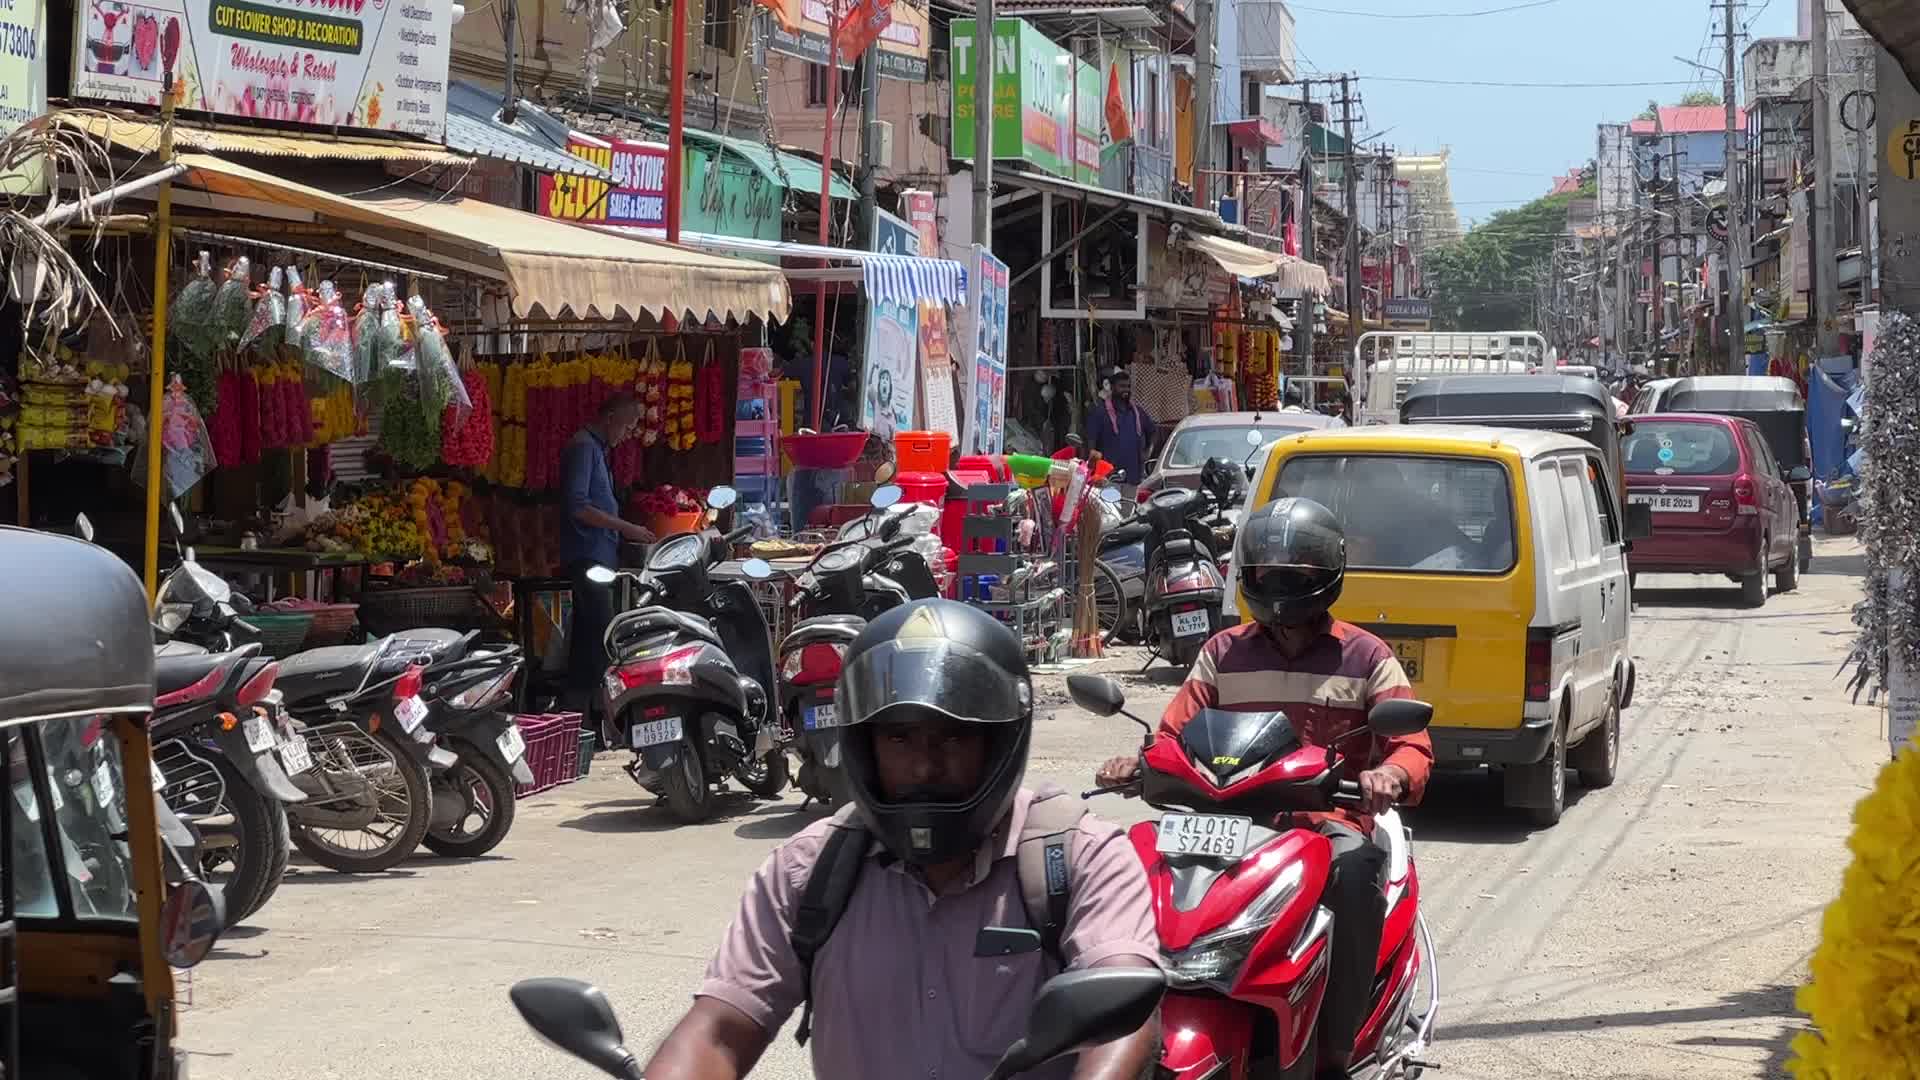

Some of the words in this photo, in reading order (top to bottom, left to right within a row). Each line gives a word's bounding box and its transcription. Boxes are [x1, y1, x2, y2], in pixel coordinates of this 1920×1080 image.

[215, 6, 234, 26] CUT
[235, 11, 271, 33] FLOWER
[272, 16, 298, 38] SHOP
[299, 20, 304, 40] &
[305, 22, 358, 46] DECORATION
[231, 42, 290, 78] Wholesale
[290, 51, 299, 75] &
[303, 53, 337, 81] Retail
[954, 36, 1016, 75] TN
[633, 154, 665, 191] STOVE
[610, 192, 631, 218] SALES
[631, 197, 636, 218] &
[637, 195, 663, 220] SERVICE
[1660, 498, 1673, 507] BE
[817, 706, 832, 717] KL
[1212, 756, 1241, 765] EVM
[1182, 817, 1240, 837] KL01C
[1178, 835, 1235, 855] S7469
